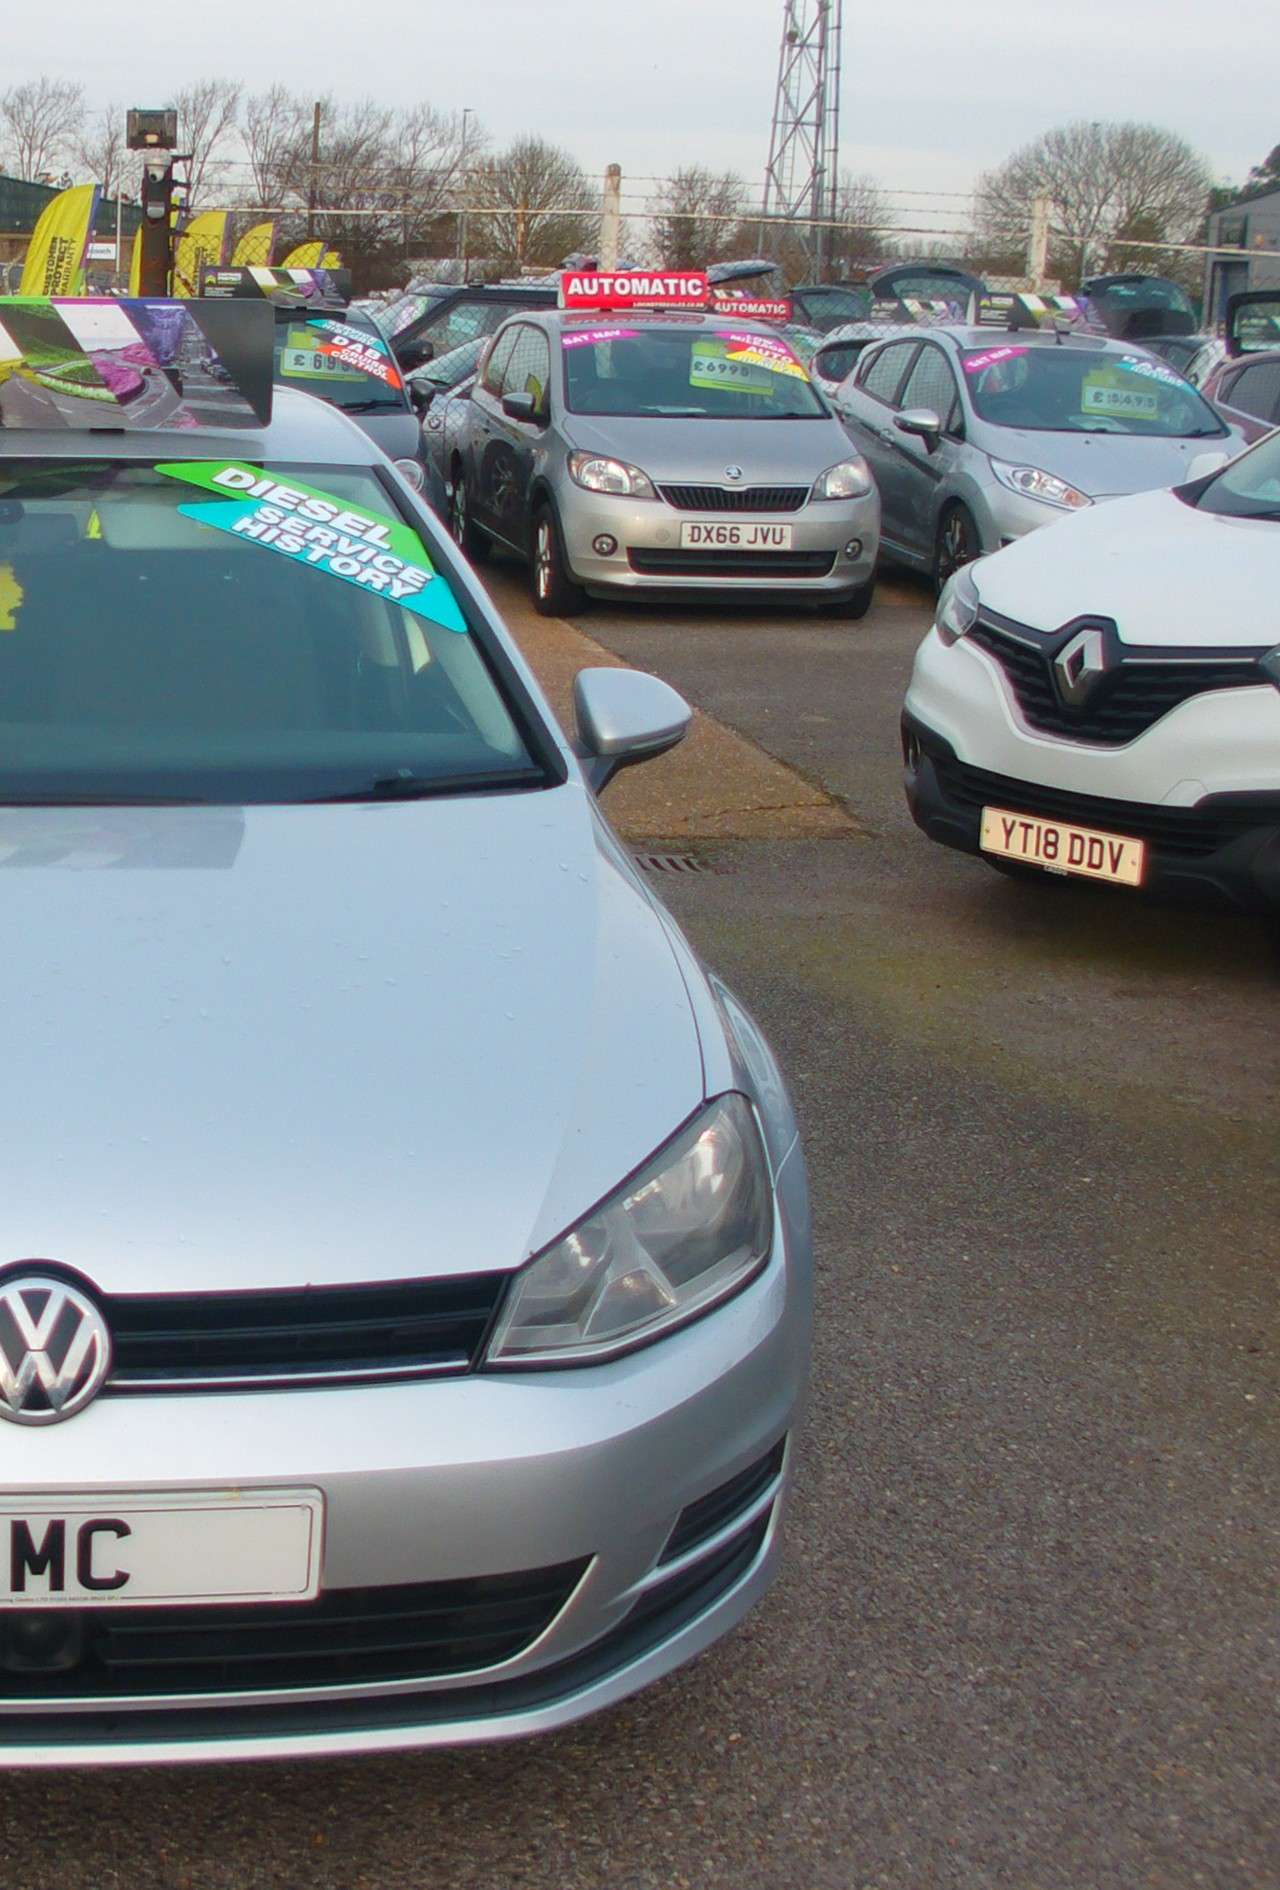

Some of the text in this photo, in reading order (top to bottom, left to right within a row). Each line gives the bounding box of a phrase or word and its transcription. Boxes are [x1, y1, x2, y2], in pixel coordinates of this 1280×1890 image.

[568, 277, 703, 296] AUTOMATIC
[714, 302, 787, 314] AUTOMATIC
[331, 335, 381, 360] DAB
[212, 467, 392, 550] DIESEL
[253, 506, 433, 588] SERVICE
[690, 525, 785, 545] DX66 JVU
[231, 516, 421, 600] HISTORY
[1002, 817, 1124, 874] YT18 DDV
